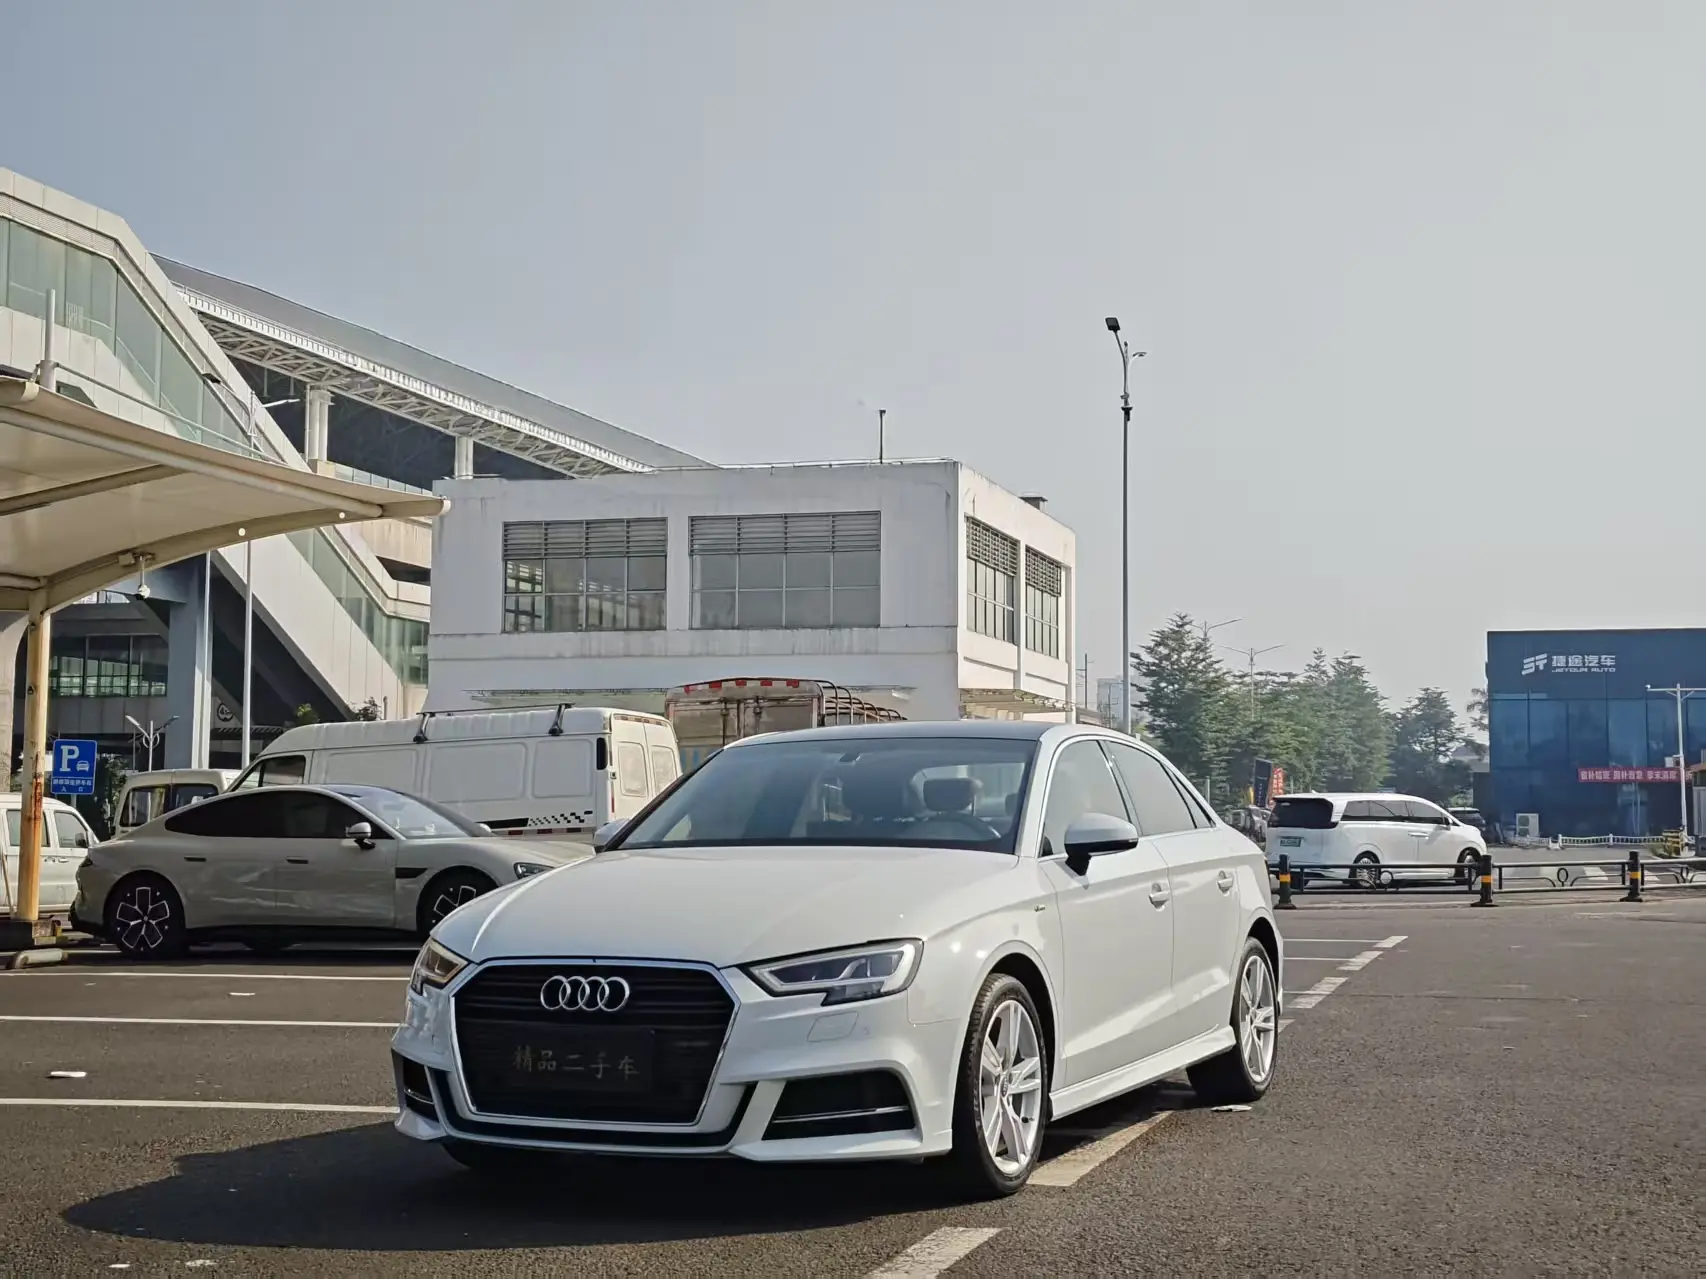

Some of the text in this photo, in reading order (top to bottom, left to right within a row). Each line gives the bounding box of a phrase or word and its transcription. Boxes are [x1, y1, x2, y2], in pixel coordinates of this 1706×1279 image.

[59, 745, 80, 772] P
[513, 1045, 640, 1081] 精品二手车
